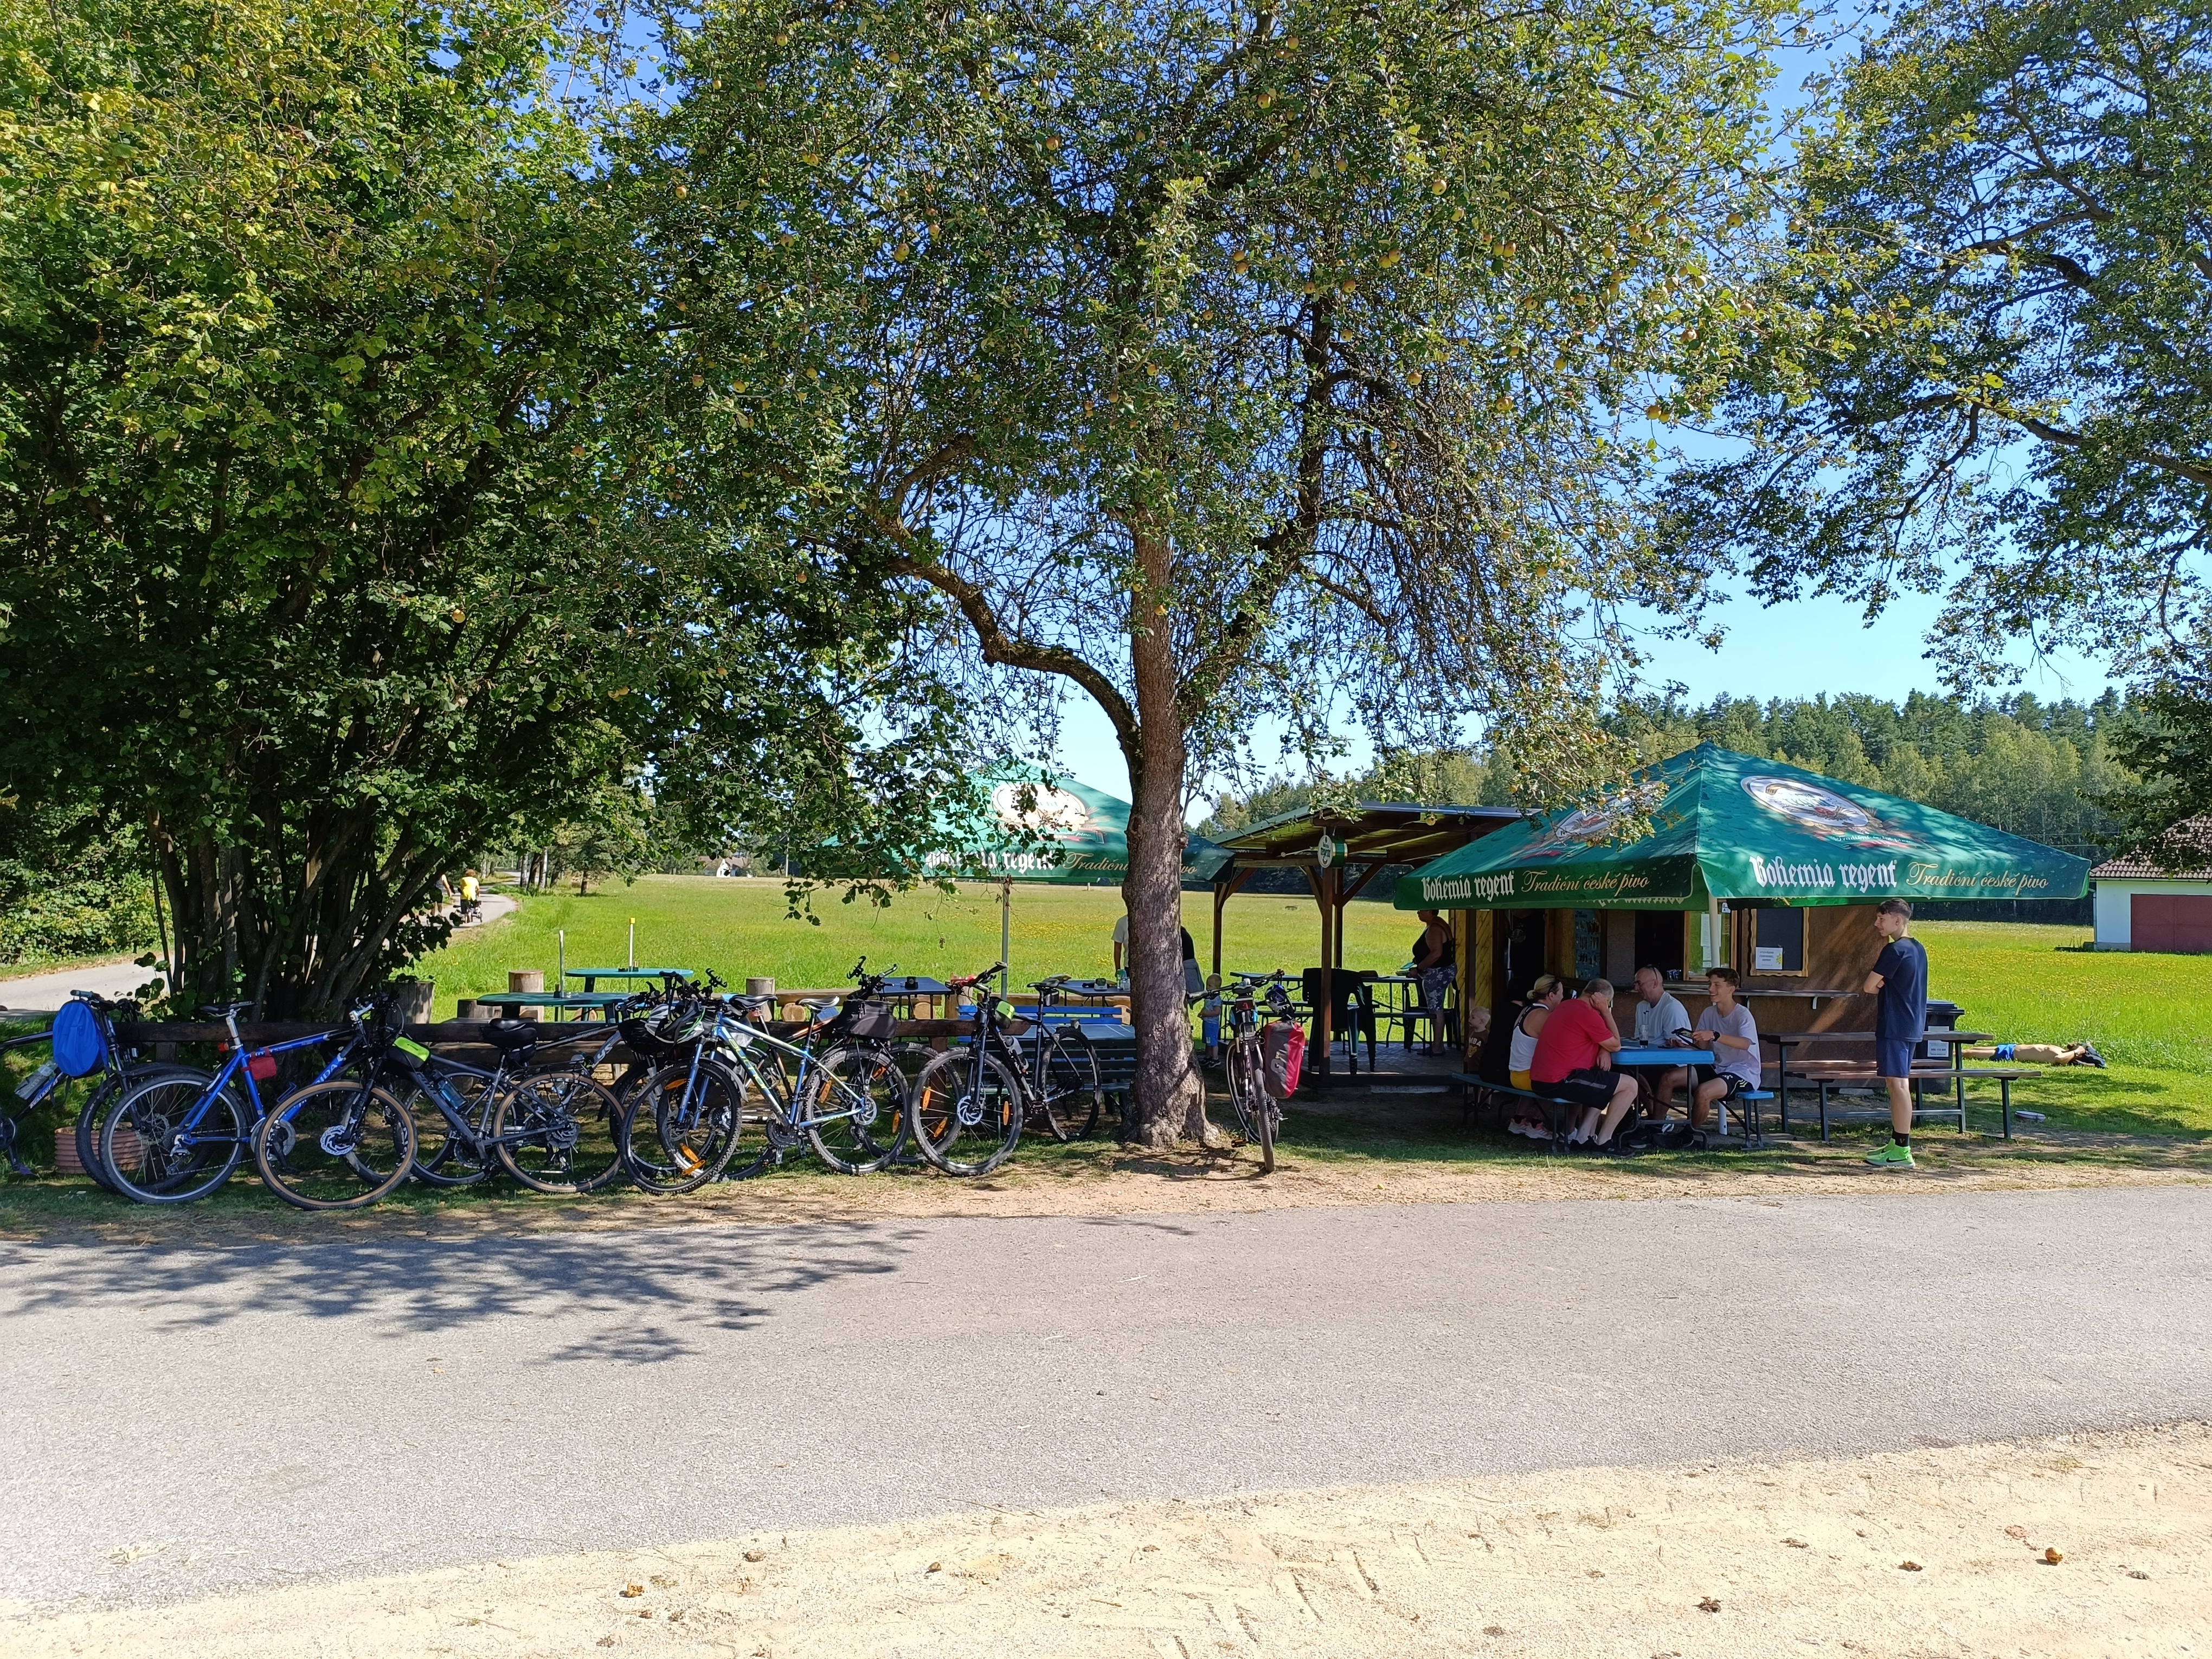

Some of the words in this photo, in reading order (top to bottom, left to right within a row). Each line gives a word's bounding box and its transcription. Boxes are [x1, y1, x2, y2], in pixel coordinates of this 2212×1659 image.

[1421, 874, 1472, 902] Bohemia
[1474, 870, 1515, 902] regent
[1521, 870, 1583, 892] Tradiční
[1583, 872, 1619, 890] české
[1614, 874, 1650, 896] pivo
[1749, 855, 1836, 888] Bohemia
[1838, 859, 1897, 893] regent
[1906, 861, 1979, 888] Tradiční
[1980, 870, 2020, 889] české
[2015, 874, 2049, 896] pivo
